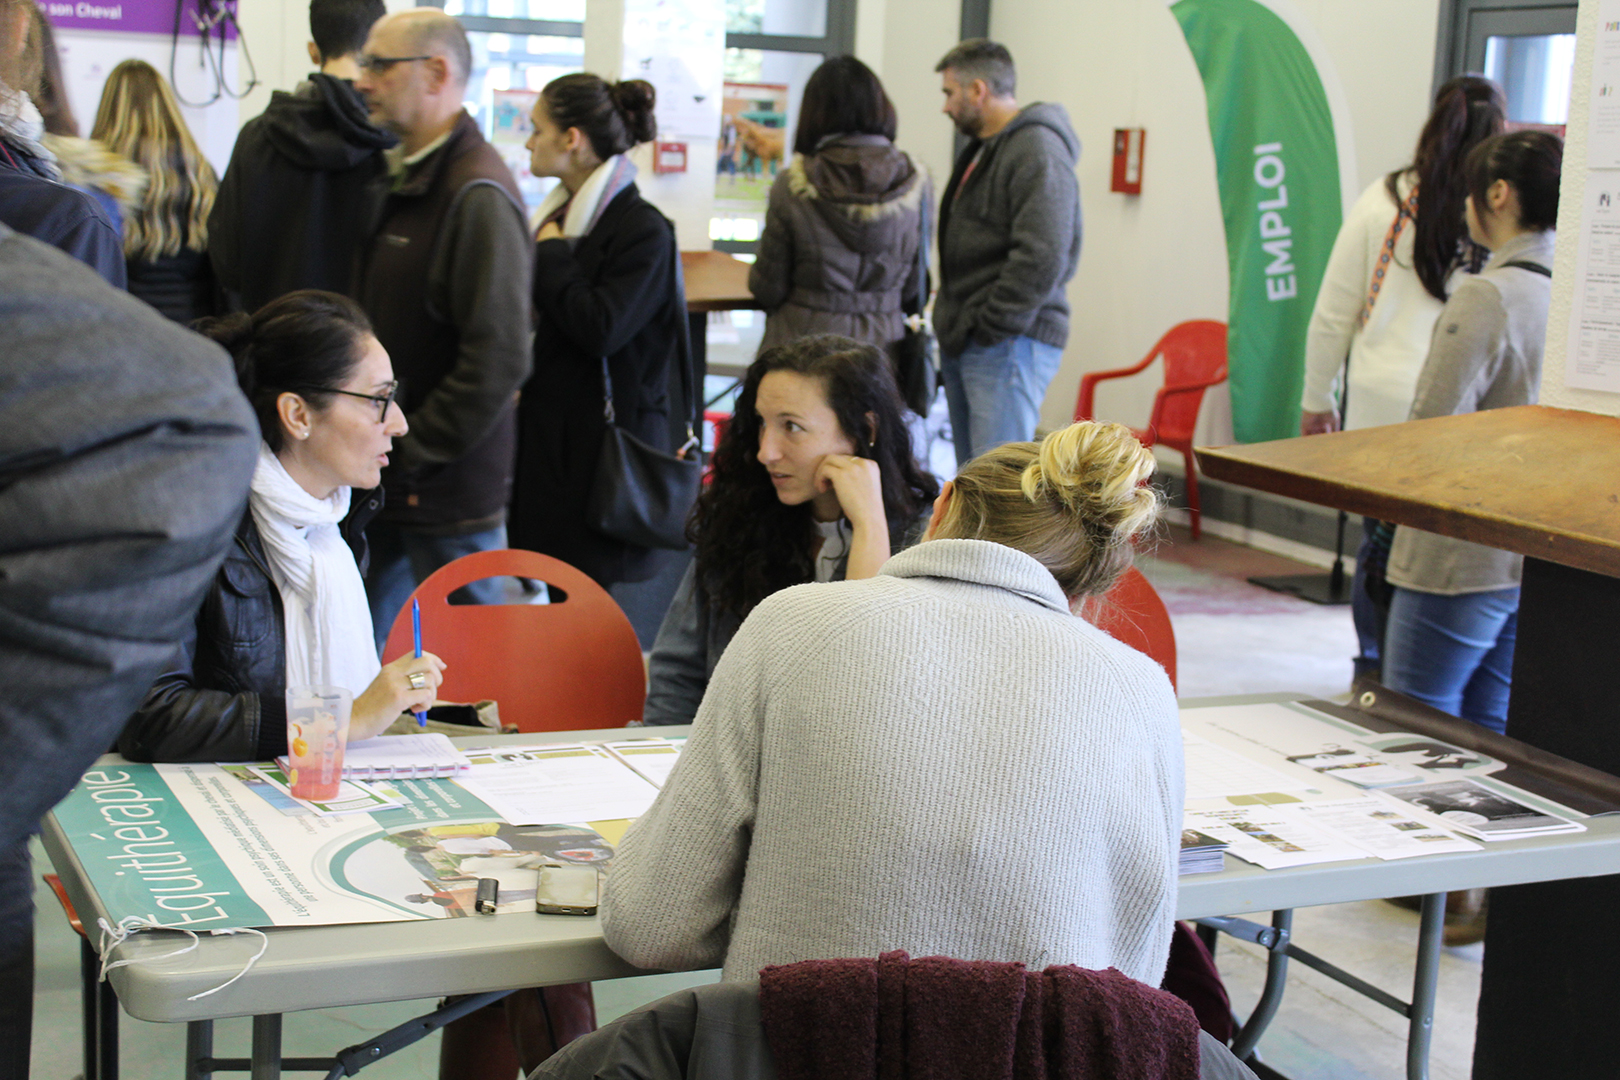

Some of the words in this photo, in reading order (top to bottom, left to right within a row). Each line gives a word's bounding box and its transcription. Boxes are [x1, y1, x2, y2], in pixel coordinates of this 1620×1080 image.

[48, 2, 74, 17] son
[75, 1, 122, 20] Cheval
[1253, 142, 1297, 302] EMPLOI
[229, 803, 258, 826] psychiques
[237, 838, 264, 860] psychique
[247, 826, 275, 851] dimensions
[267, 851, 282, 860] ses
[274, 860, 291, 872] dans
[265, 878, 281, 887] est
[284, 872, 314, 895] personne
[272, 887, 310, 917] L'équithérapie
